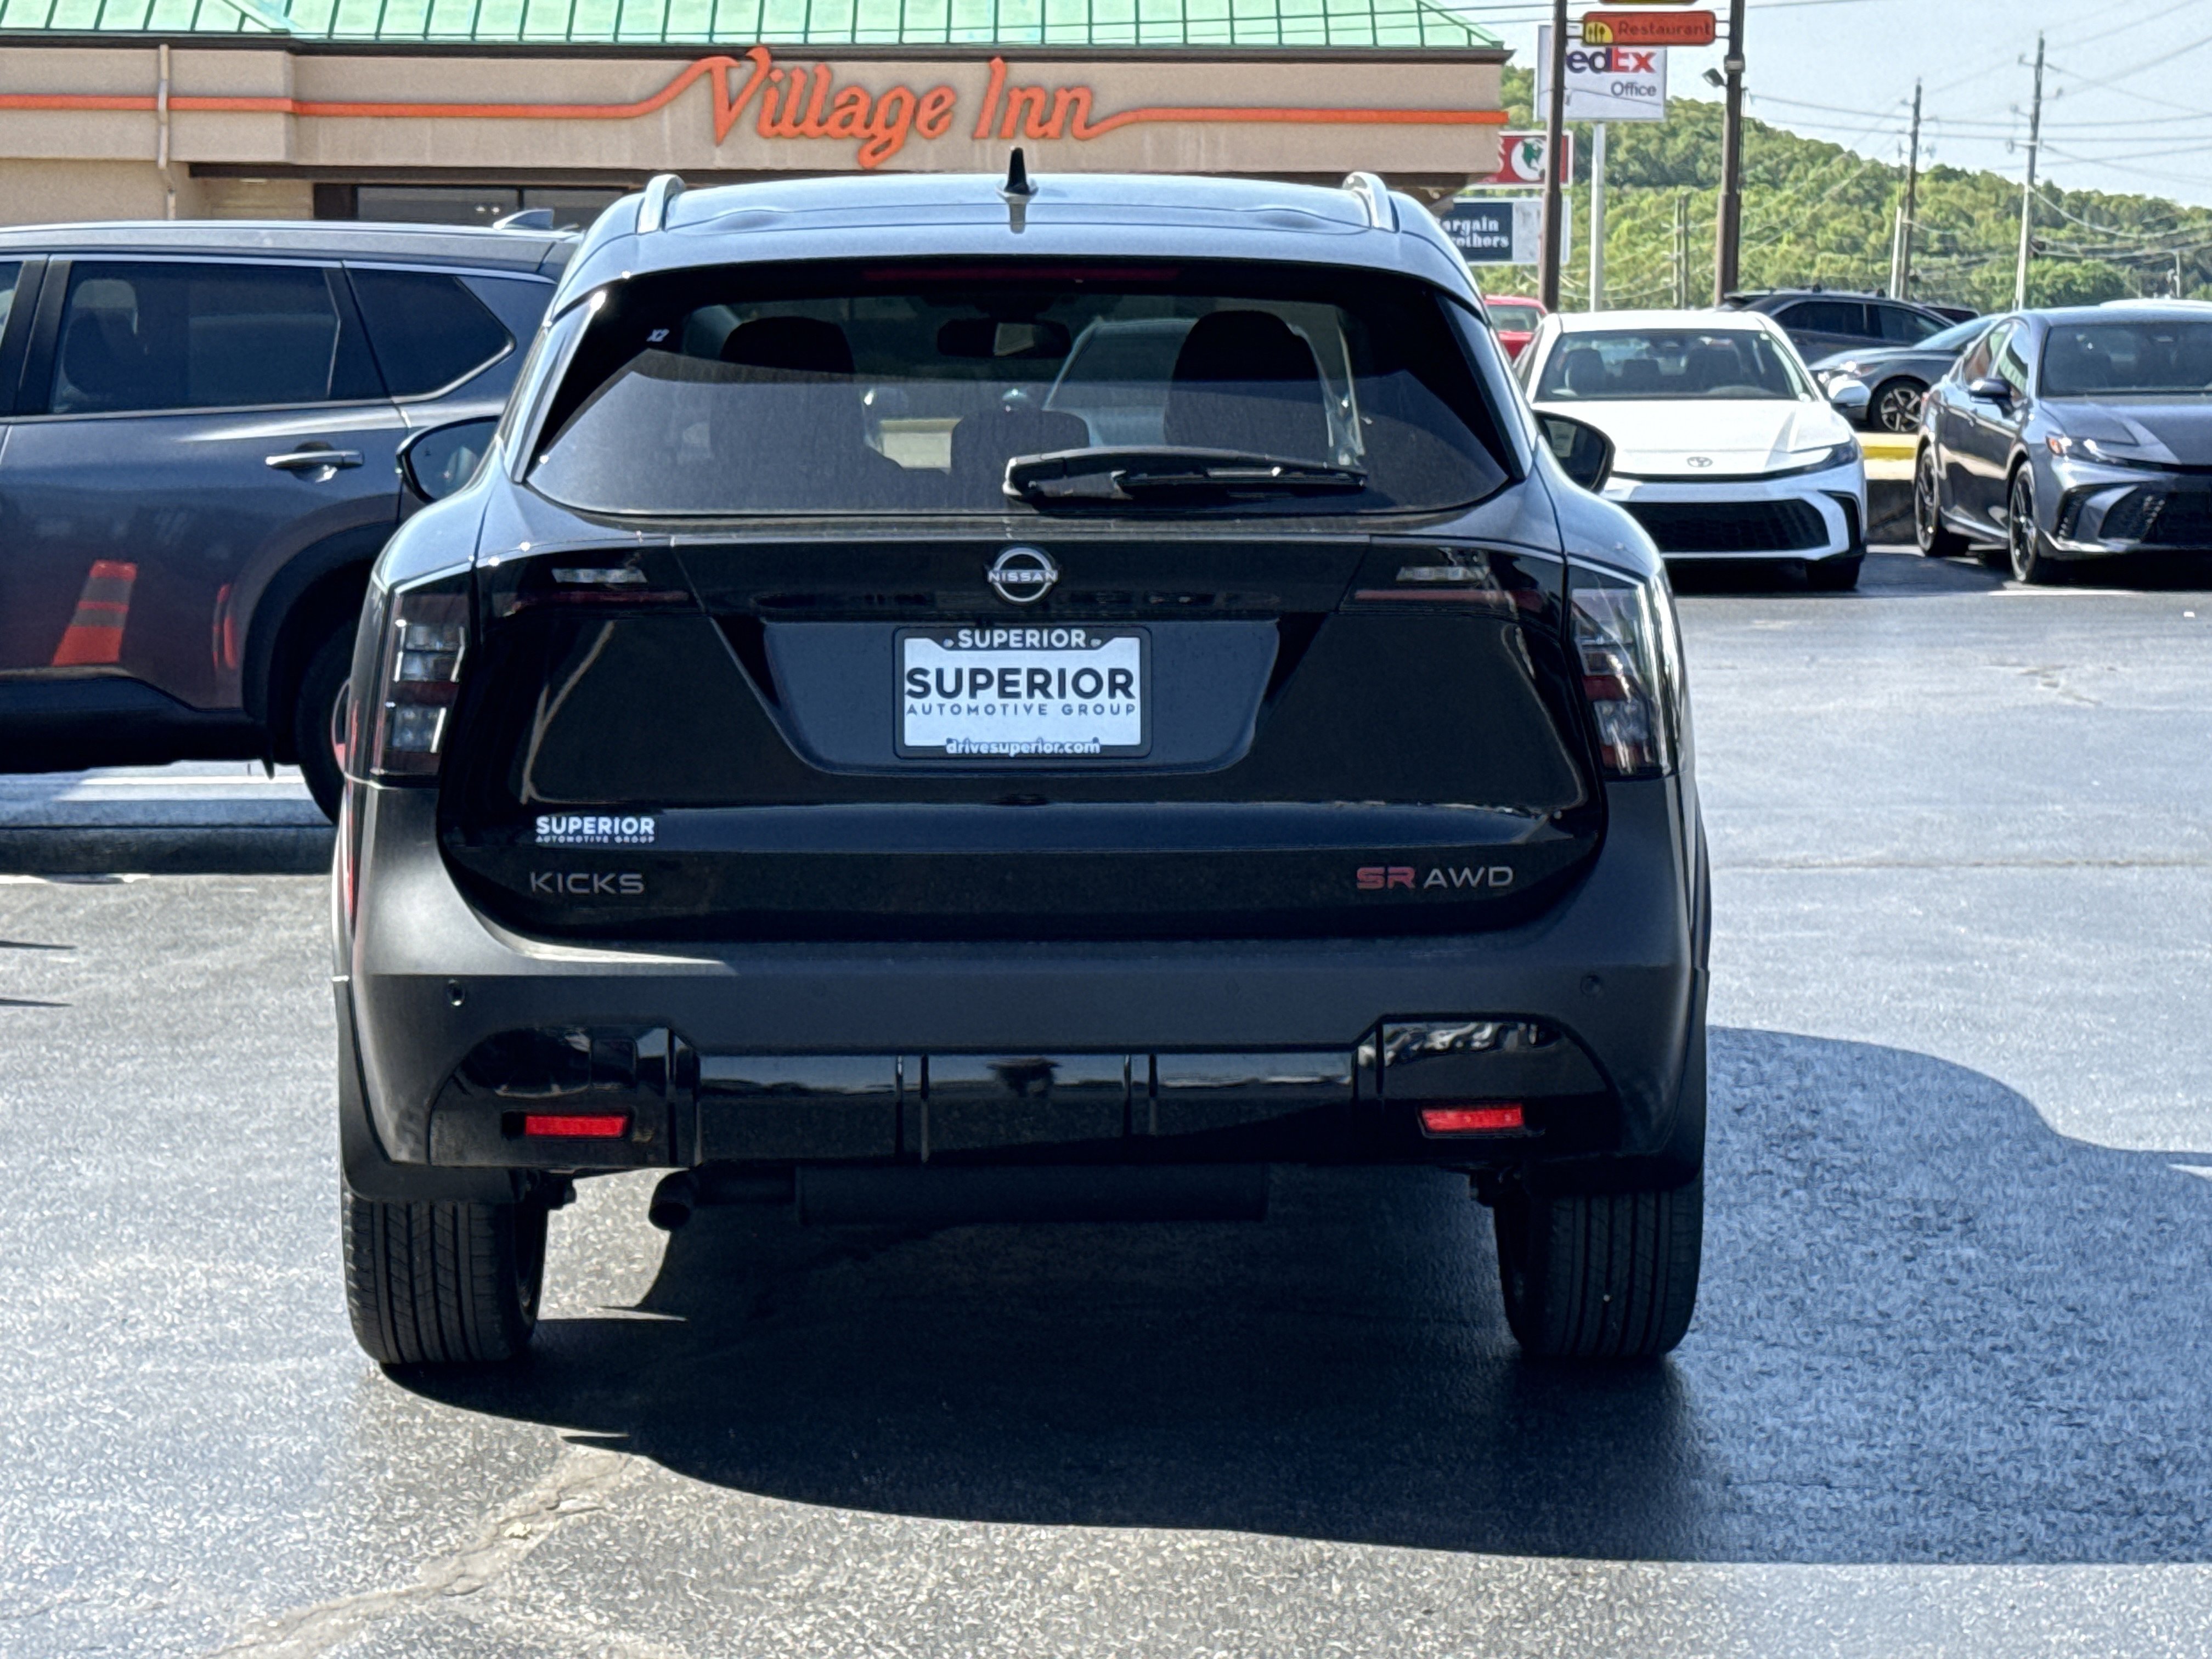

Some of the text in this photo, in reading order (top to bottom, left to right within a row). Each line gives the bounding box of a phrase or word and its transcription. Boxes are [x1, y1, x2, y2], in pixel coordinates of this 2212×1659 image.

[1618, 21, 1711, 36] Restaurant
[1566, 47, 1656, 74] edEx
[1611, 81, 1657, 97] Office
[692, 46, 1097, 168] Village Inn
[1435, 216, 1499, 236] argain
[988, 569, 1058, 583] NISSAN
[957, 629, 1087, 648] SUPERIOR
[905, 667, 1136, 699] SUPERIOR
[906, 703, 1136, 716] AUTOMOTIVE GROUP
[945, 738, 1101, 758] drivesuperior.com
[535, 816, 655, 835] SUPERIOR
[530, 872, 645, 895] KICKS
[1356, 867, 1514, 889] SR AWD
